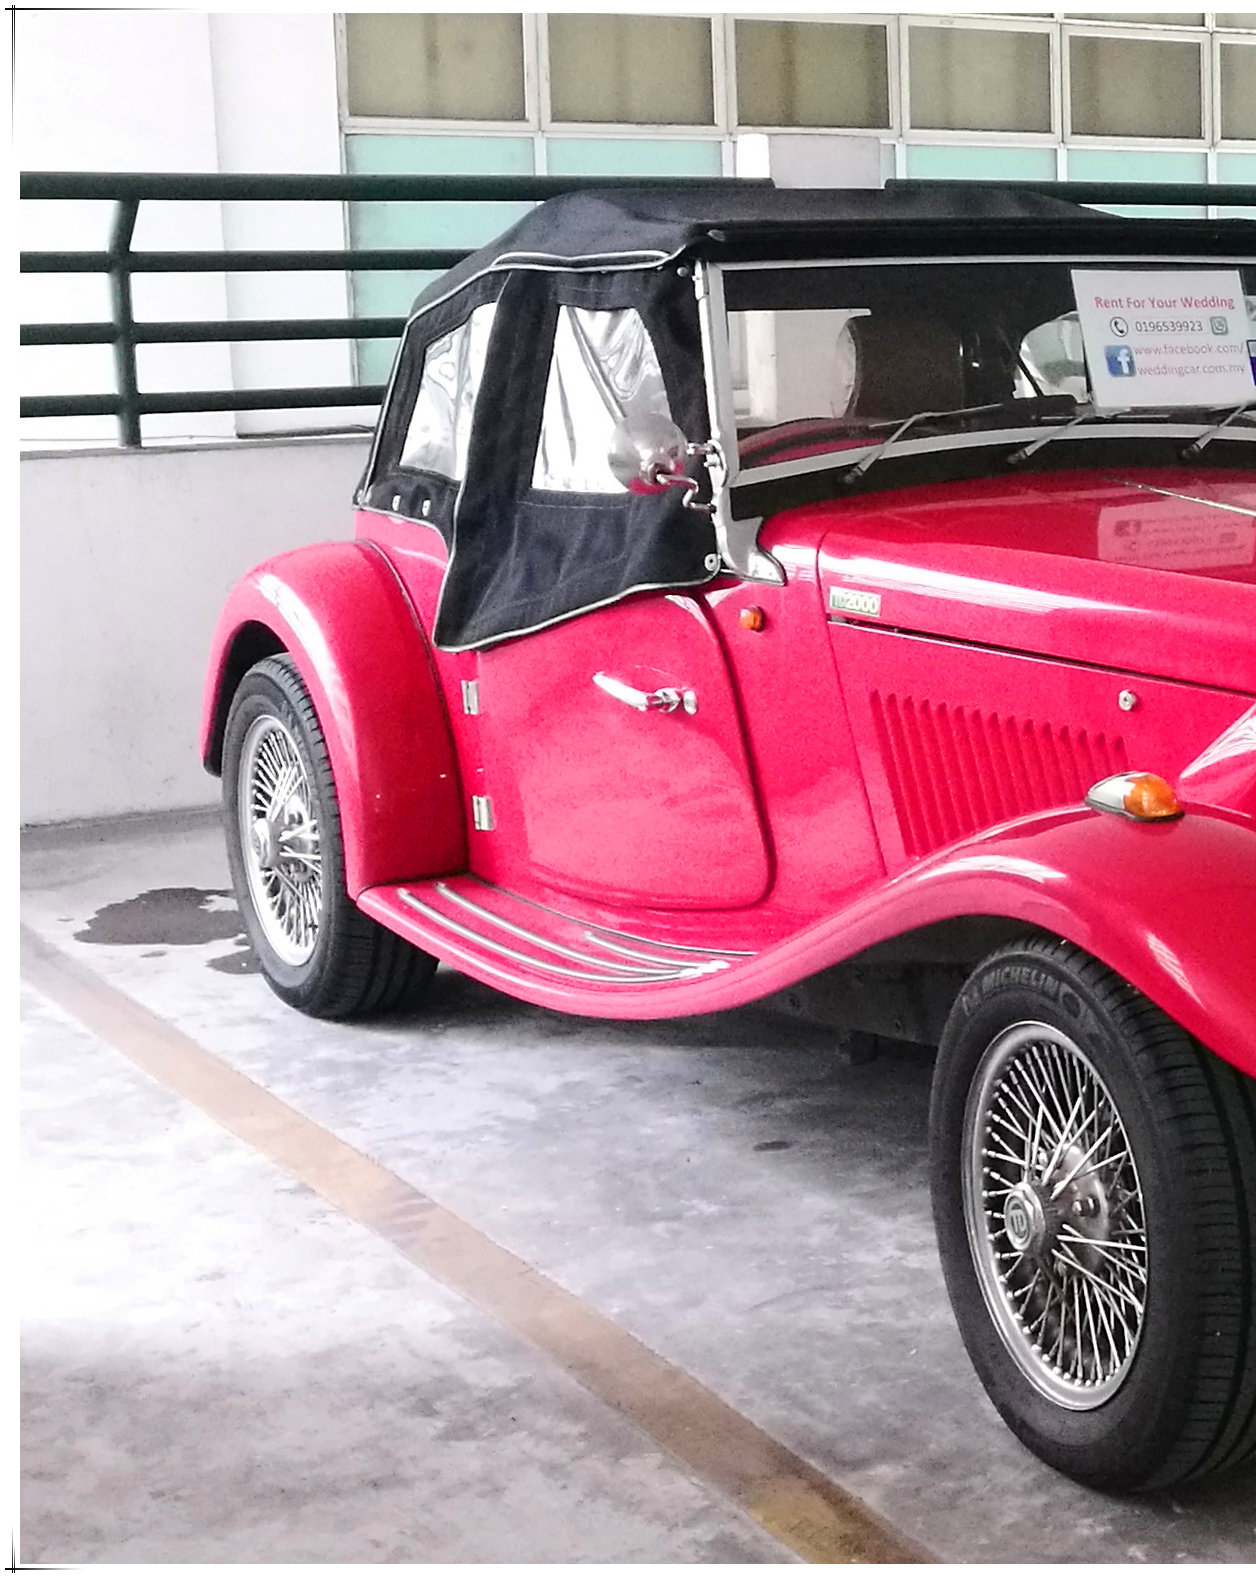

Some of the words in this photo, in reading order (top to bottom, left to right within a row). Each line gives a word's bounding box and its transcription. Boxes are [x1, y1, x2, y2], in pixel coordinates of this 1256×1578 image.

[1095, 296, 1124, 309] Rent
[1126, 297, 1146, 309] For
[1149, 297, 1178, 309] Your
[1181, 296, 1235, 309] Wedding
[1135, 320, 1203, 332] 0196539923
[1135, 341, 1244, 356] www.facebook.com/
[1137, 363, 1246, 376] weddingcar.com.my
[981, 965, 1060, 995] MICHELIN
